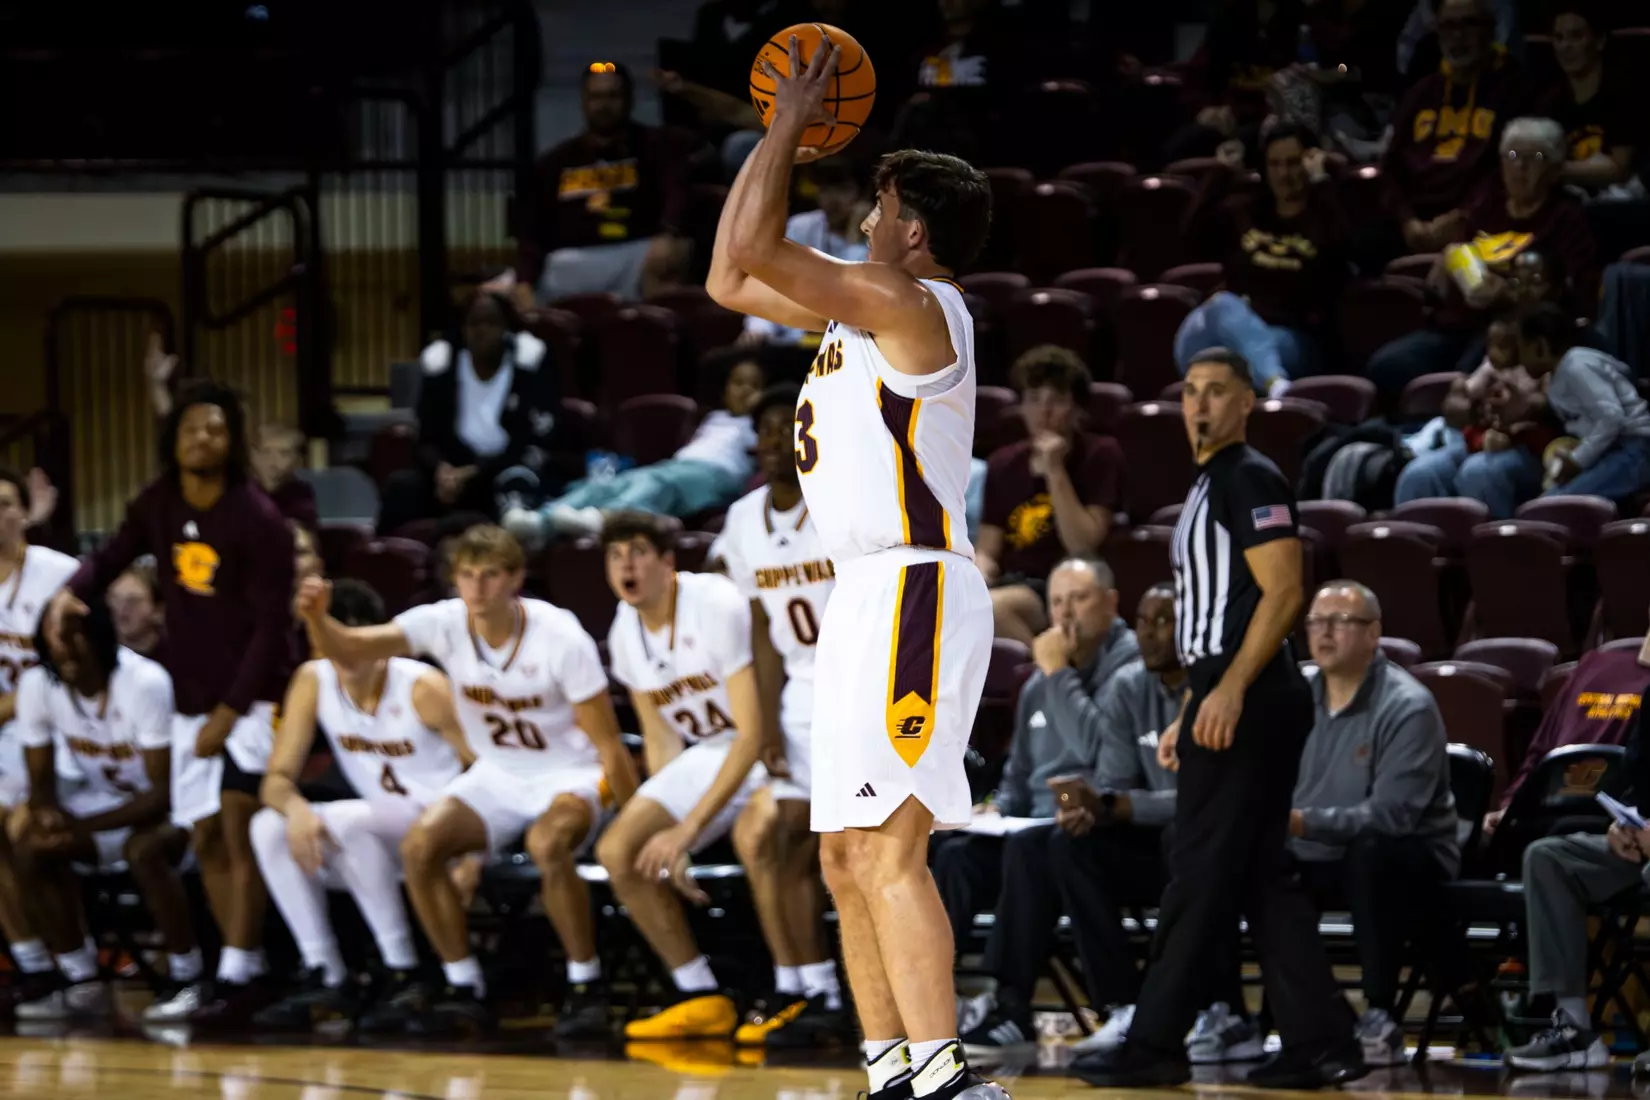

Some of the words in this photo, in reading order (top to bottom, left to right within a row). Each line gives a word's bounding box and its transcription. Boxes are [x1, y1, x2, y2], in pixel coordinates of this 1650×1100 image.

[795, 398, 819, 474] 3
[787, 597, 820, 646] 0
[484, 712, 547, 752] 20
[673, 699, 738, 740] 24
